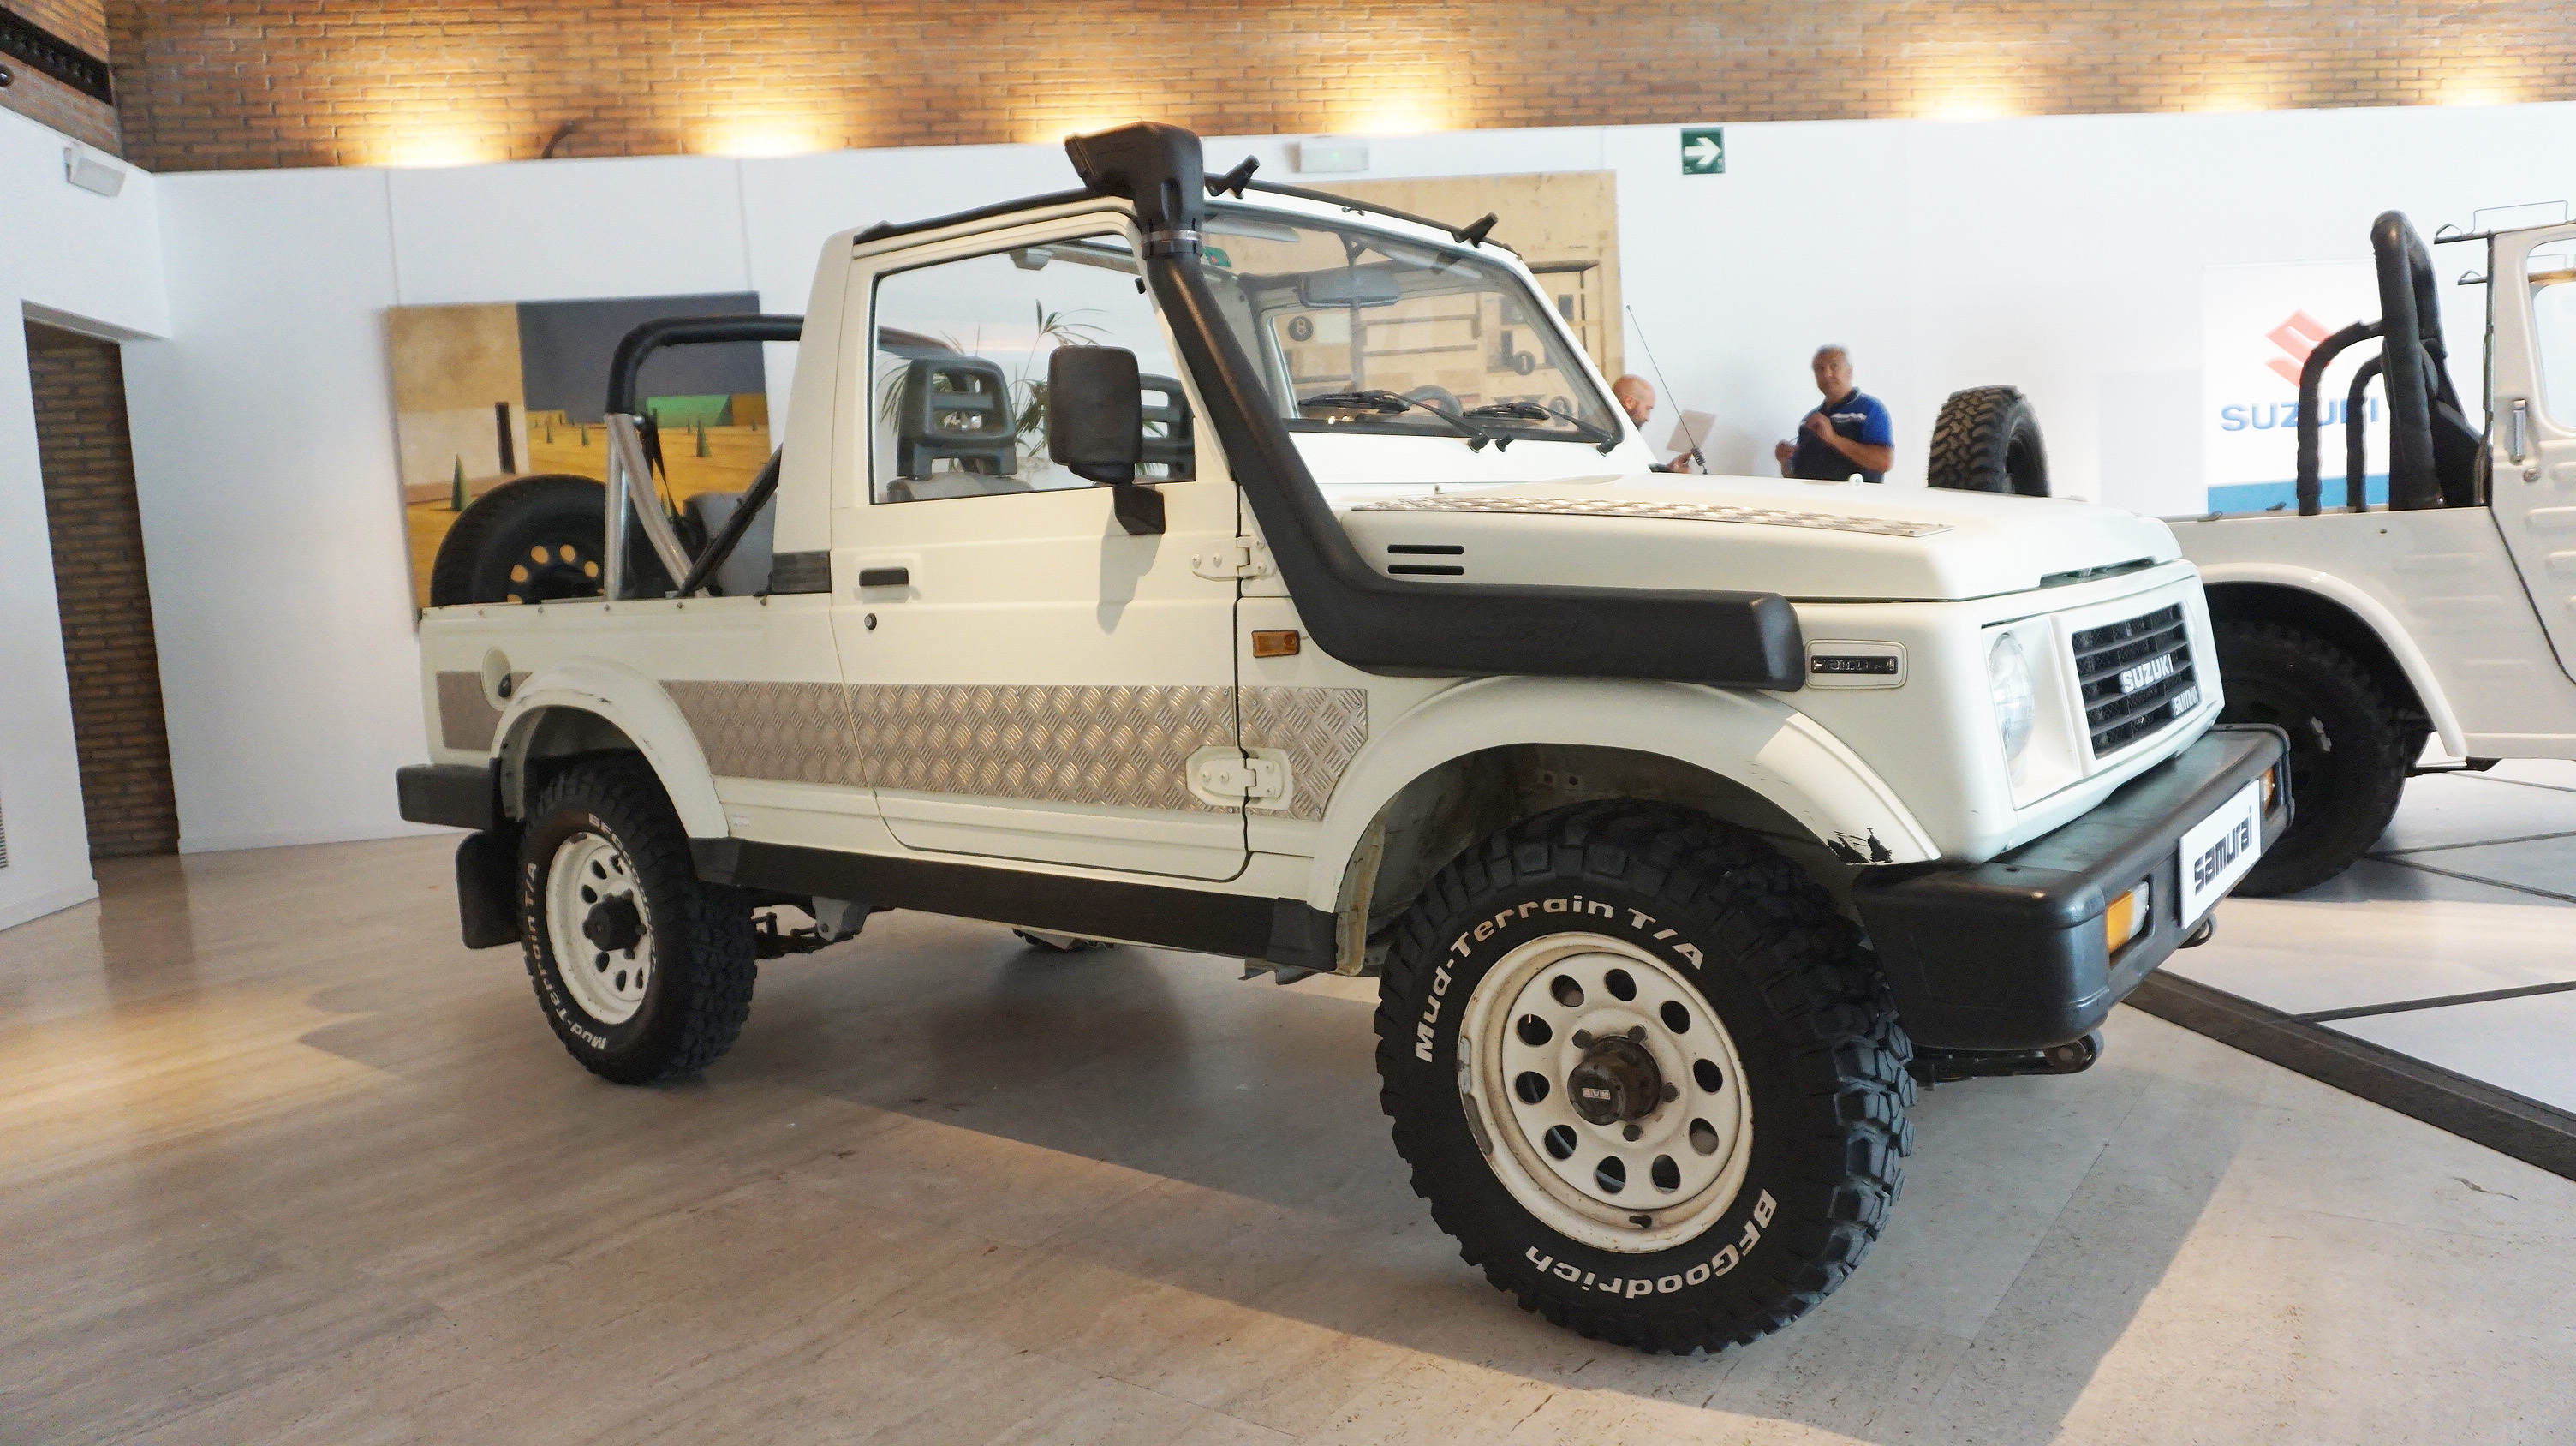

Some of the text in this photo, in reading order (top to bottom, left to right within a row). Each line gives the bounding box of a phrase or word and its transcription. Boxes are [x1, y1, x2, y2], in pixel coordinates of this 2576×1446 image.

[2221, 396, 2379, 431] SUZUI
[2123, 654, 2174, 692] SUZUKI
[2194, 804, 2252, 896] samurai
[524, 863, 538, 907] T/A
[1416, 895, 1704, 1062] Mud-Terrain T/A
[1525, 1188, 1777, 1299] BFGoodrich
